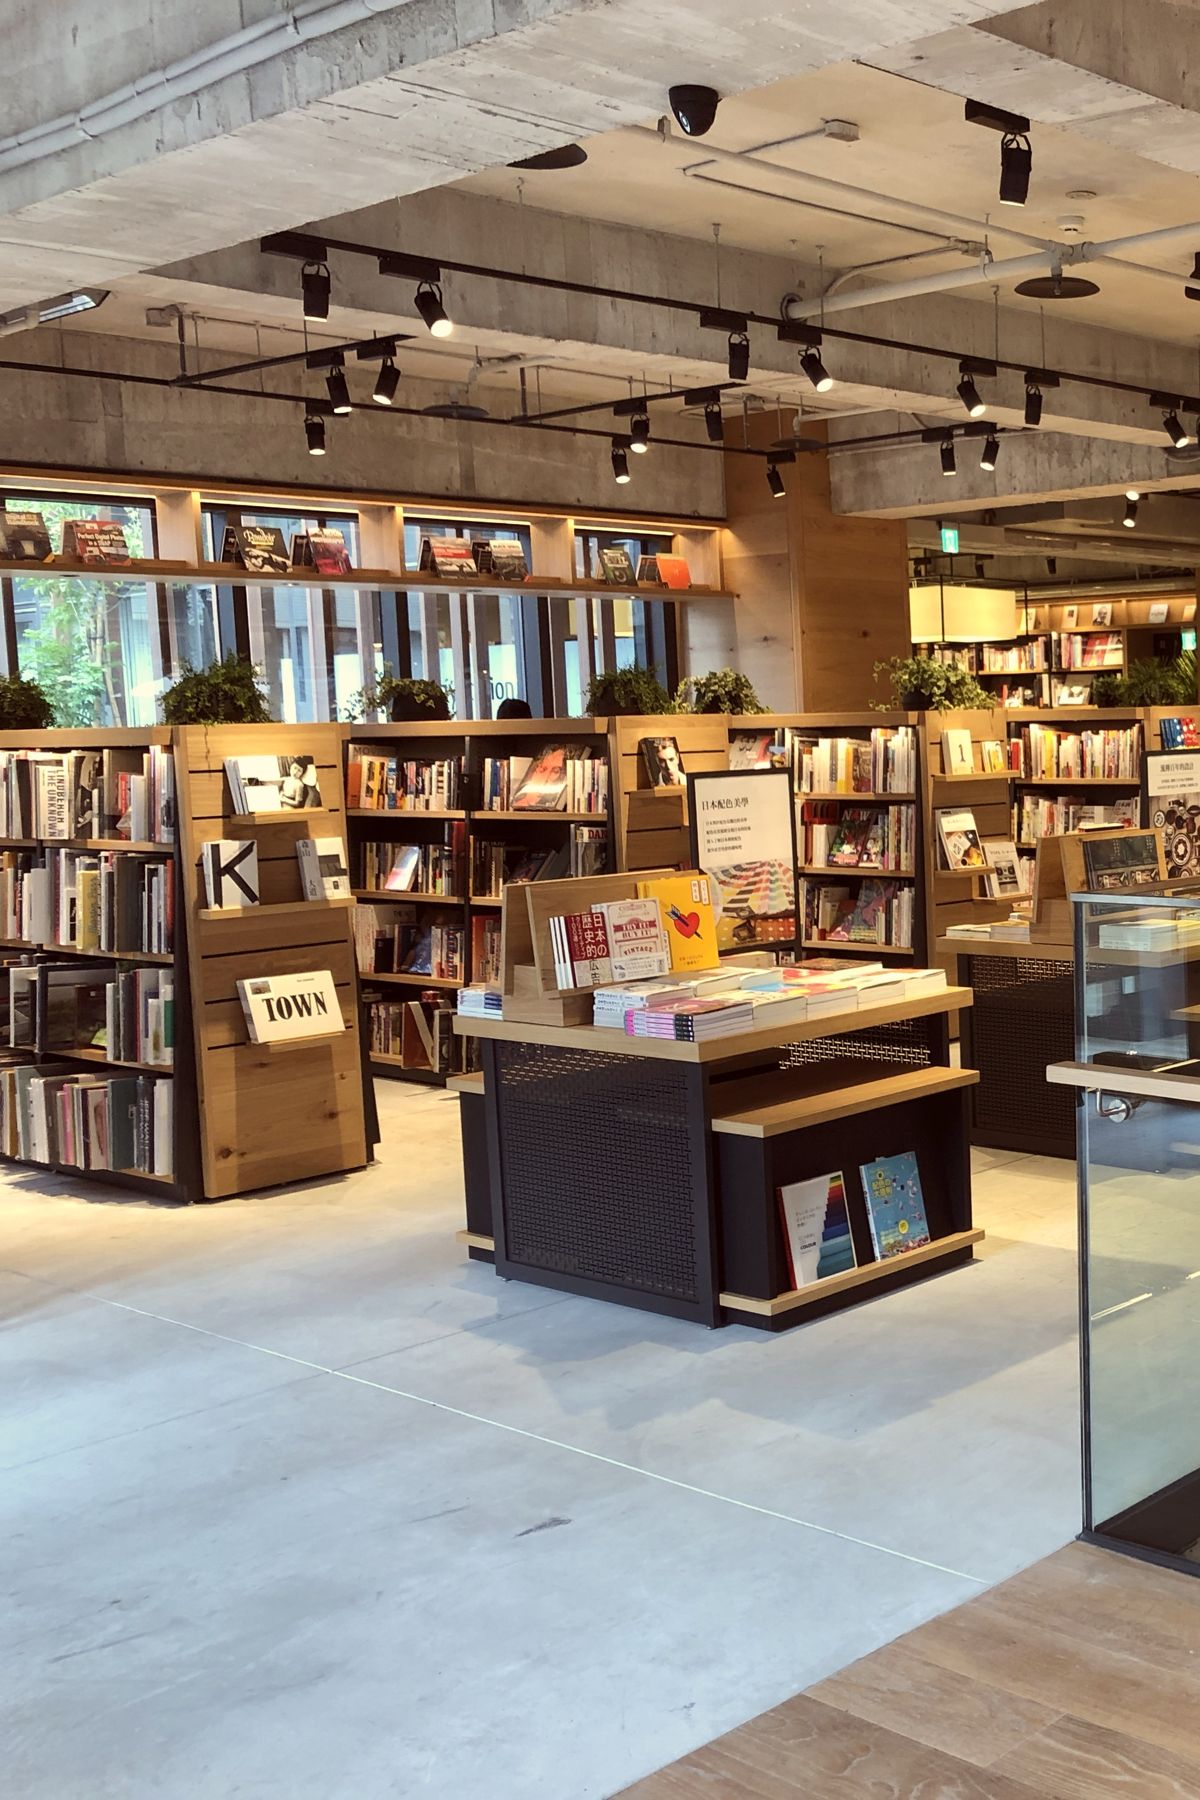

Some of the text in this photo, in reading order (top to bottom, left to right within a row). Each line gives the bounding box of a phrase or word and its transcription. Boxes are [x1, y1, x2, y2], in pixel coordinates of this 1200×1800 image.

[47, 770, 57, 837] THE UNKNOWN
[702, 797, 749, 811] 日本配色美學
[593, 914, 607, 957] 日本の
[624, 945, 653, 956] VINTAGE
[262, 991, 328, 1022] TOWN
